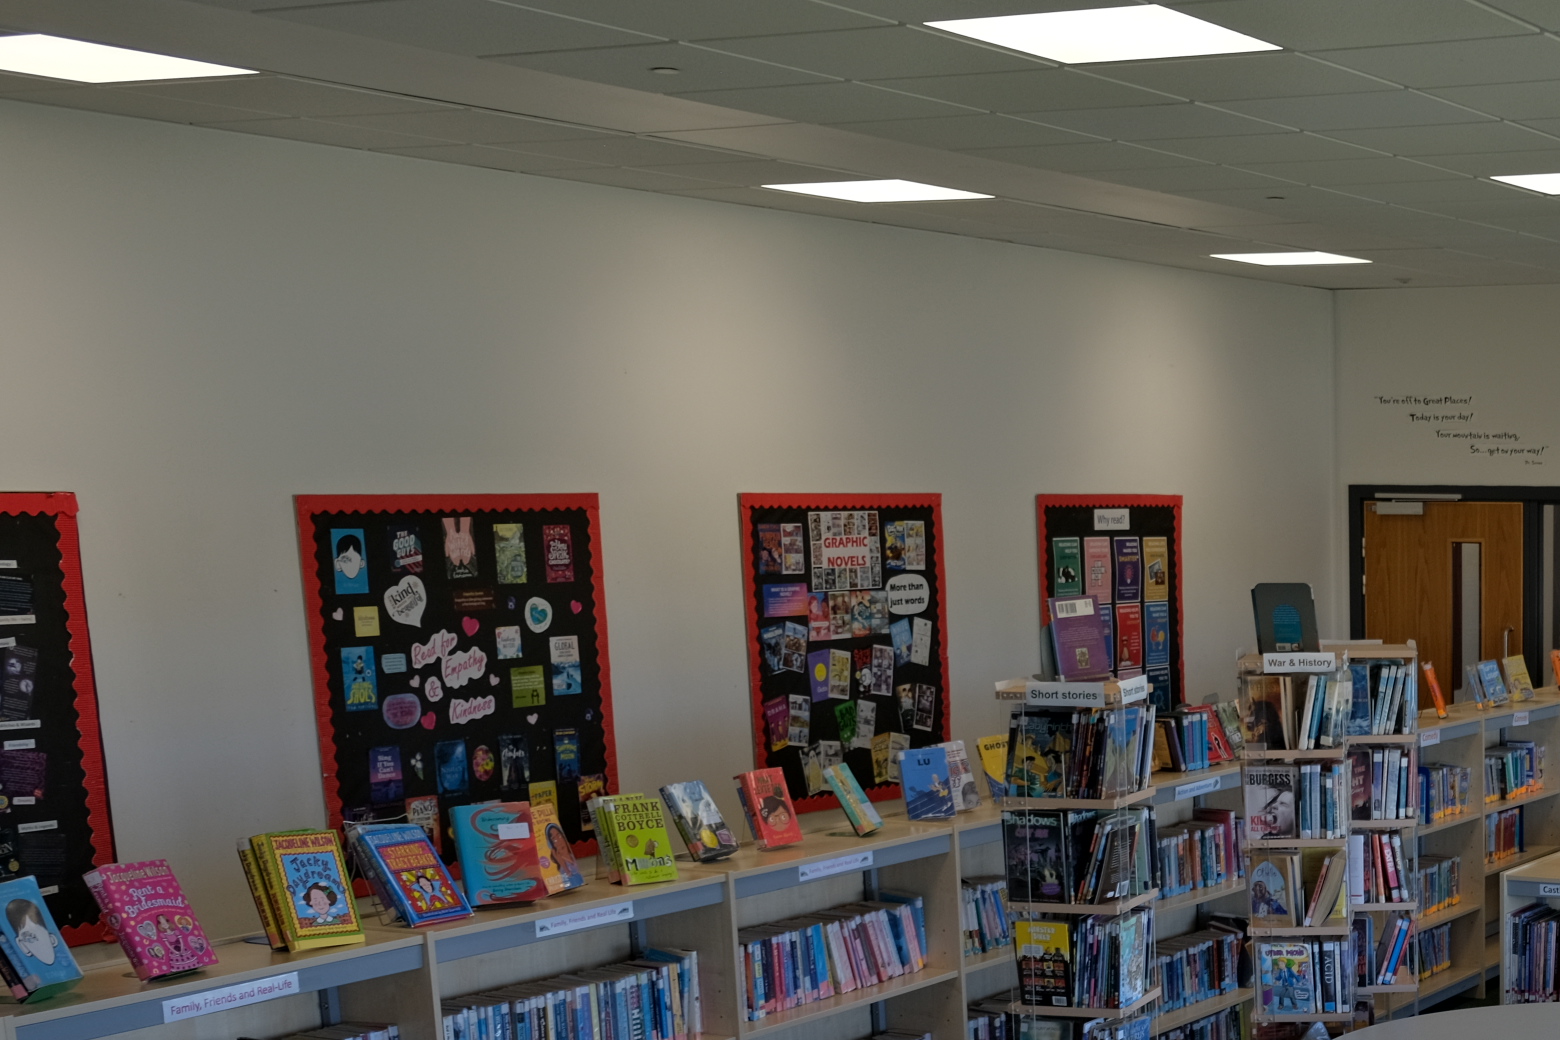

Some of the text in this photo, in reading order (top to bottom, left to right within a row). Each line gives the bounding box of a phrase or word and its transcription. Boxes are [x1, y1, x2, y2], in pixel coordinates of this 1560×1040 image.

[1410, 414, 1431, 422] Today
[1097, 515, 1125, 525] Why read?
[824, 536, 868, 549] GRAPHIC
[827, 556, 866, 567] NOVELS
[890, 583, 923, 592] More than
[890, 596, 925, 607] just words
[444, 654, 486, 679] Empathy
[1268, 659, 1332, 668] War & History
[428, 681, 440, 697] &
[1031, 690, 1098, 700] Short stories
[452, 699, 492, 719] Kindness
[917, 758, 931, 767] LU
[1250, 773, 1291, 785] BURGESS
[614, 801, 660, 815] FRANK
[615, 811, 663, 820] COTTRELL
[1006, 815, 1057, 827] shadows
[617, 818, 665, 832] BOYCE
[274, 835, 333, 850] JACQUELINE WILSON
[107, 865, 170, 885] Jacqueline Wilson
[129, 887, 164, 903] Rent a
[125, 896, 186, 918] Bridesmaid
[1324, 956, 1333, 984] ACID
[170, 980, 293, 1016] Family, Friends and Real-Life
